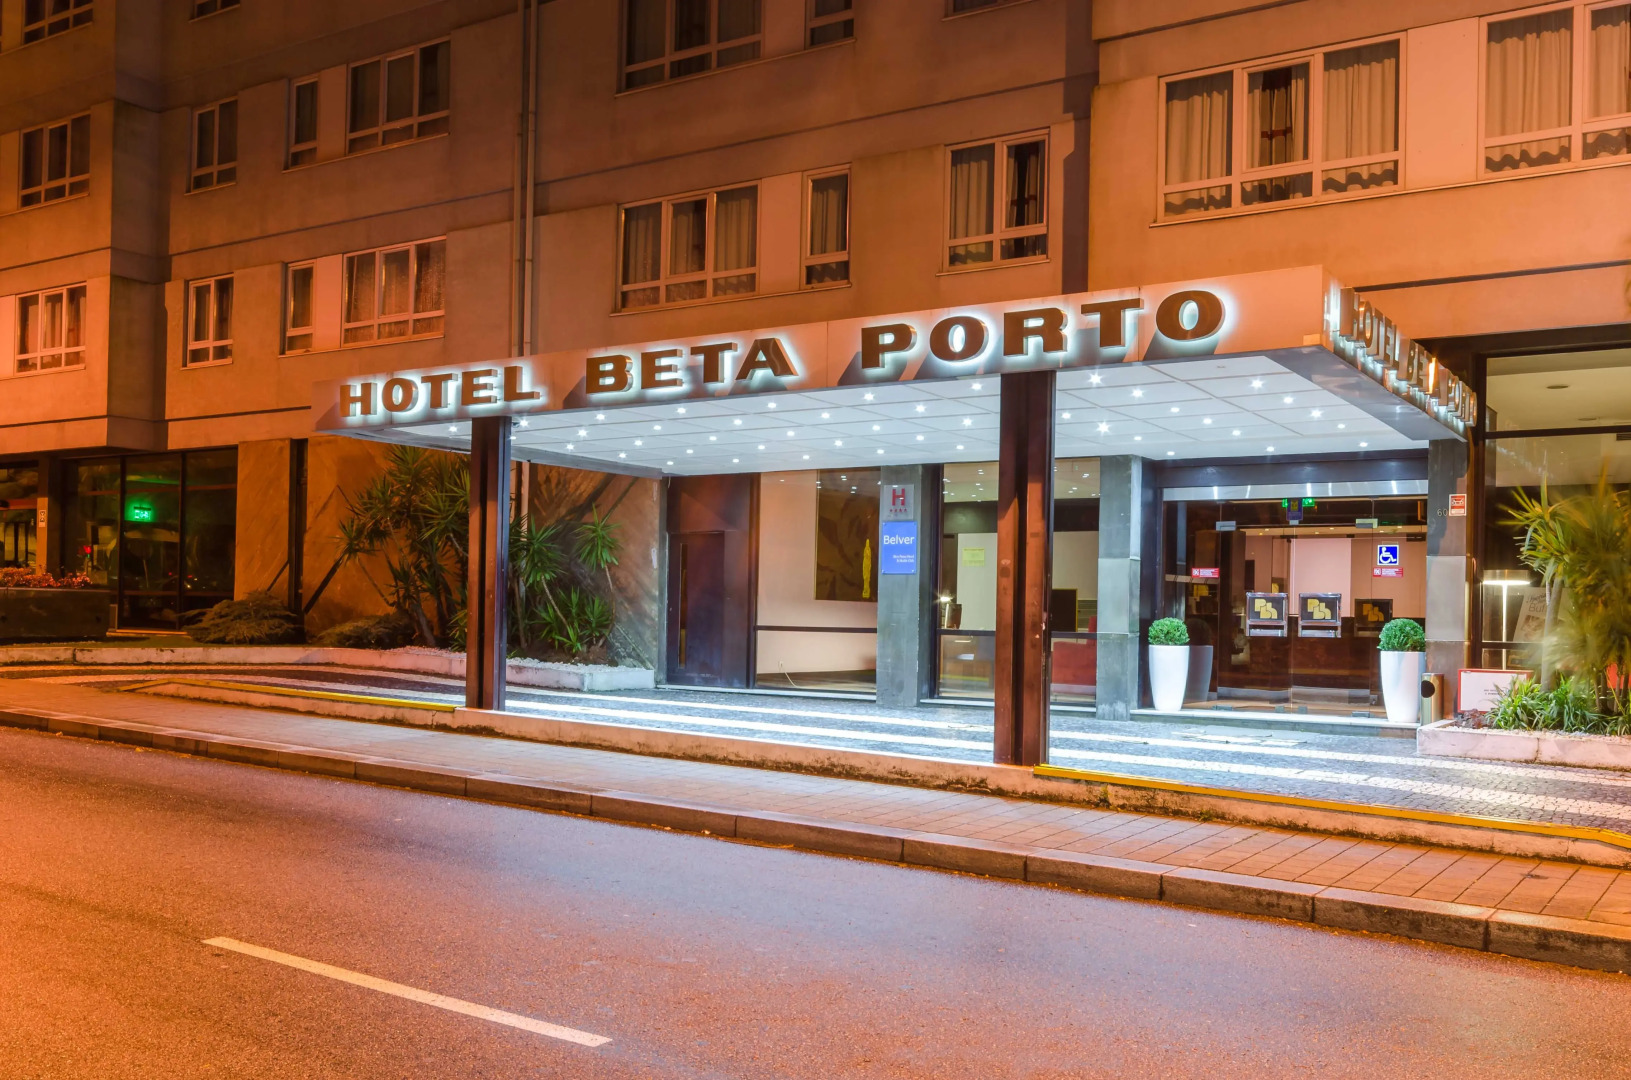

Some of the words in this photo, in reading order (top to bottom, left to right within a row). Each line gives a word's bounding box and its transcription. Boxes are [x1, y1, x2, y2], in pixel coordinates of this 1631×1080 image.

[339, 365, 541, 418] HOTEL
[585, 337, 800, 394] BETA
[861, 289, 1226, 370] PORTO
[892, 488, 905, 506] H
[1437, 508, 1448, 517] 60
[883, 534, 915, 545] Belver
